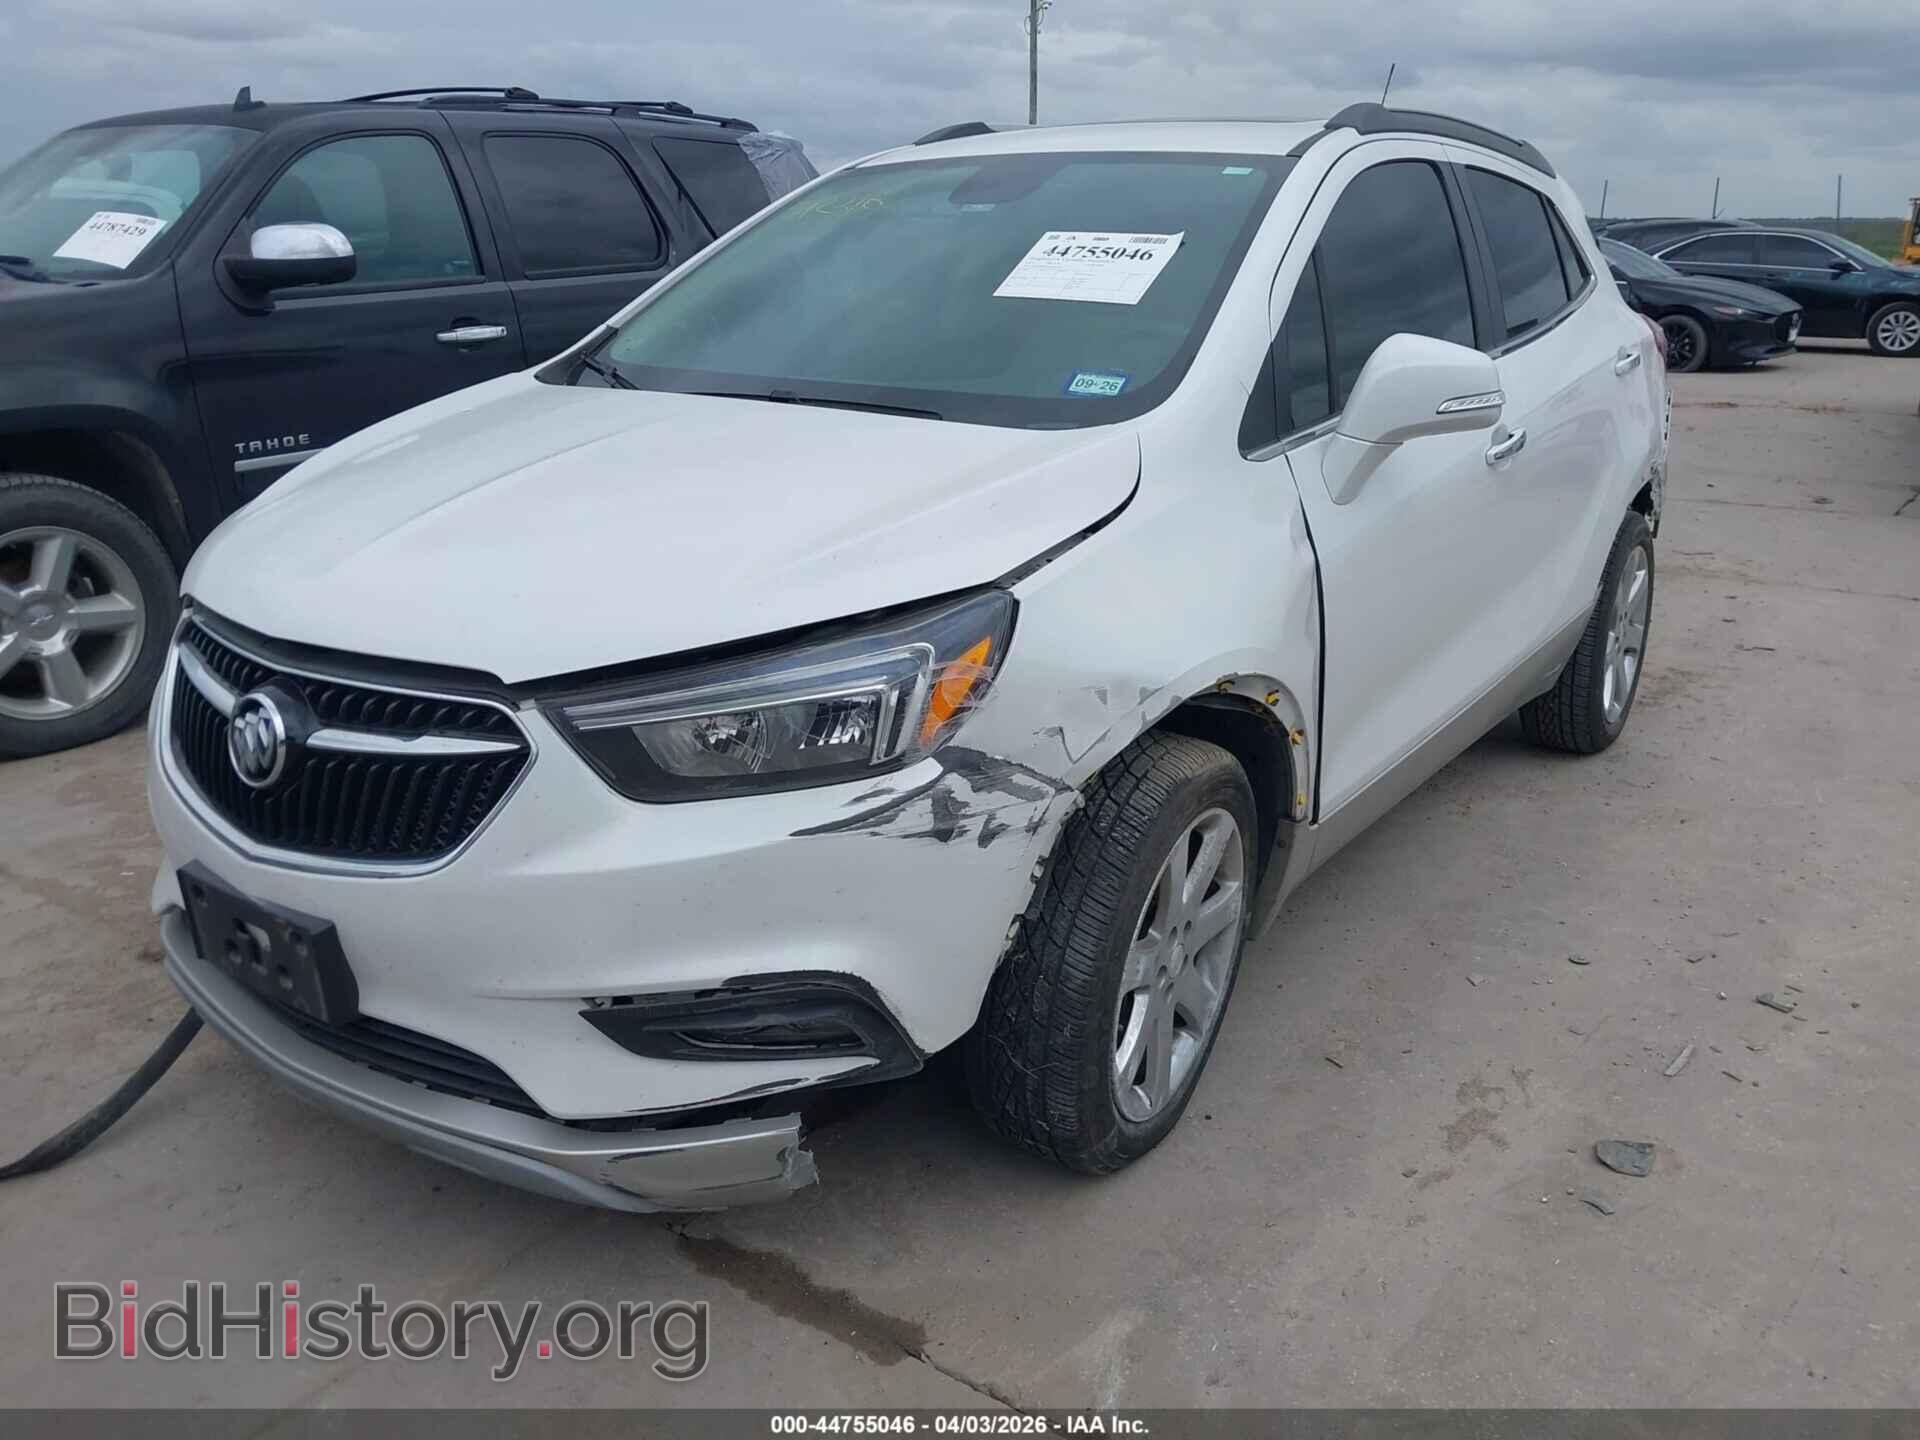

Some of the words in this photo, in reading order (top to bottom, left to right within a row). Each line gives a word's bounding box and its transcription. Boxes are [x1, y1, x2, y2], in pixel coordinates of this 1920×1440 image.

[88, 221, 147, 237] 44787429
[1042, 244, 1154, 261] 44755046
[234, 433, 311, 454] TAHOE
